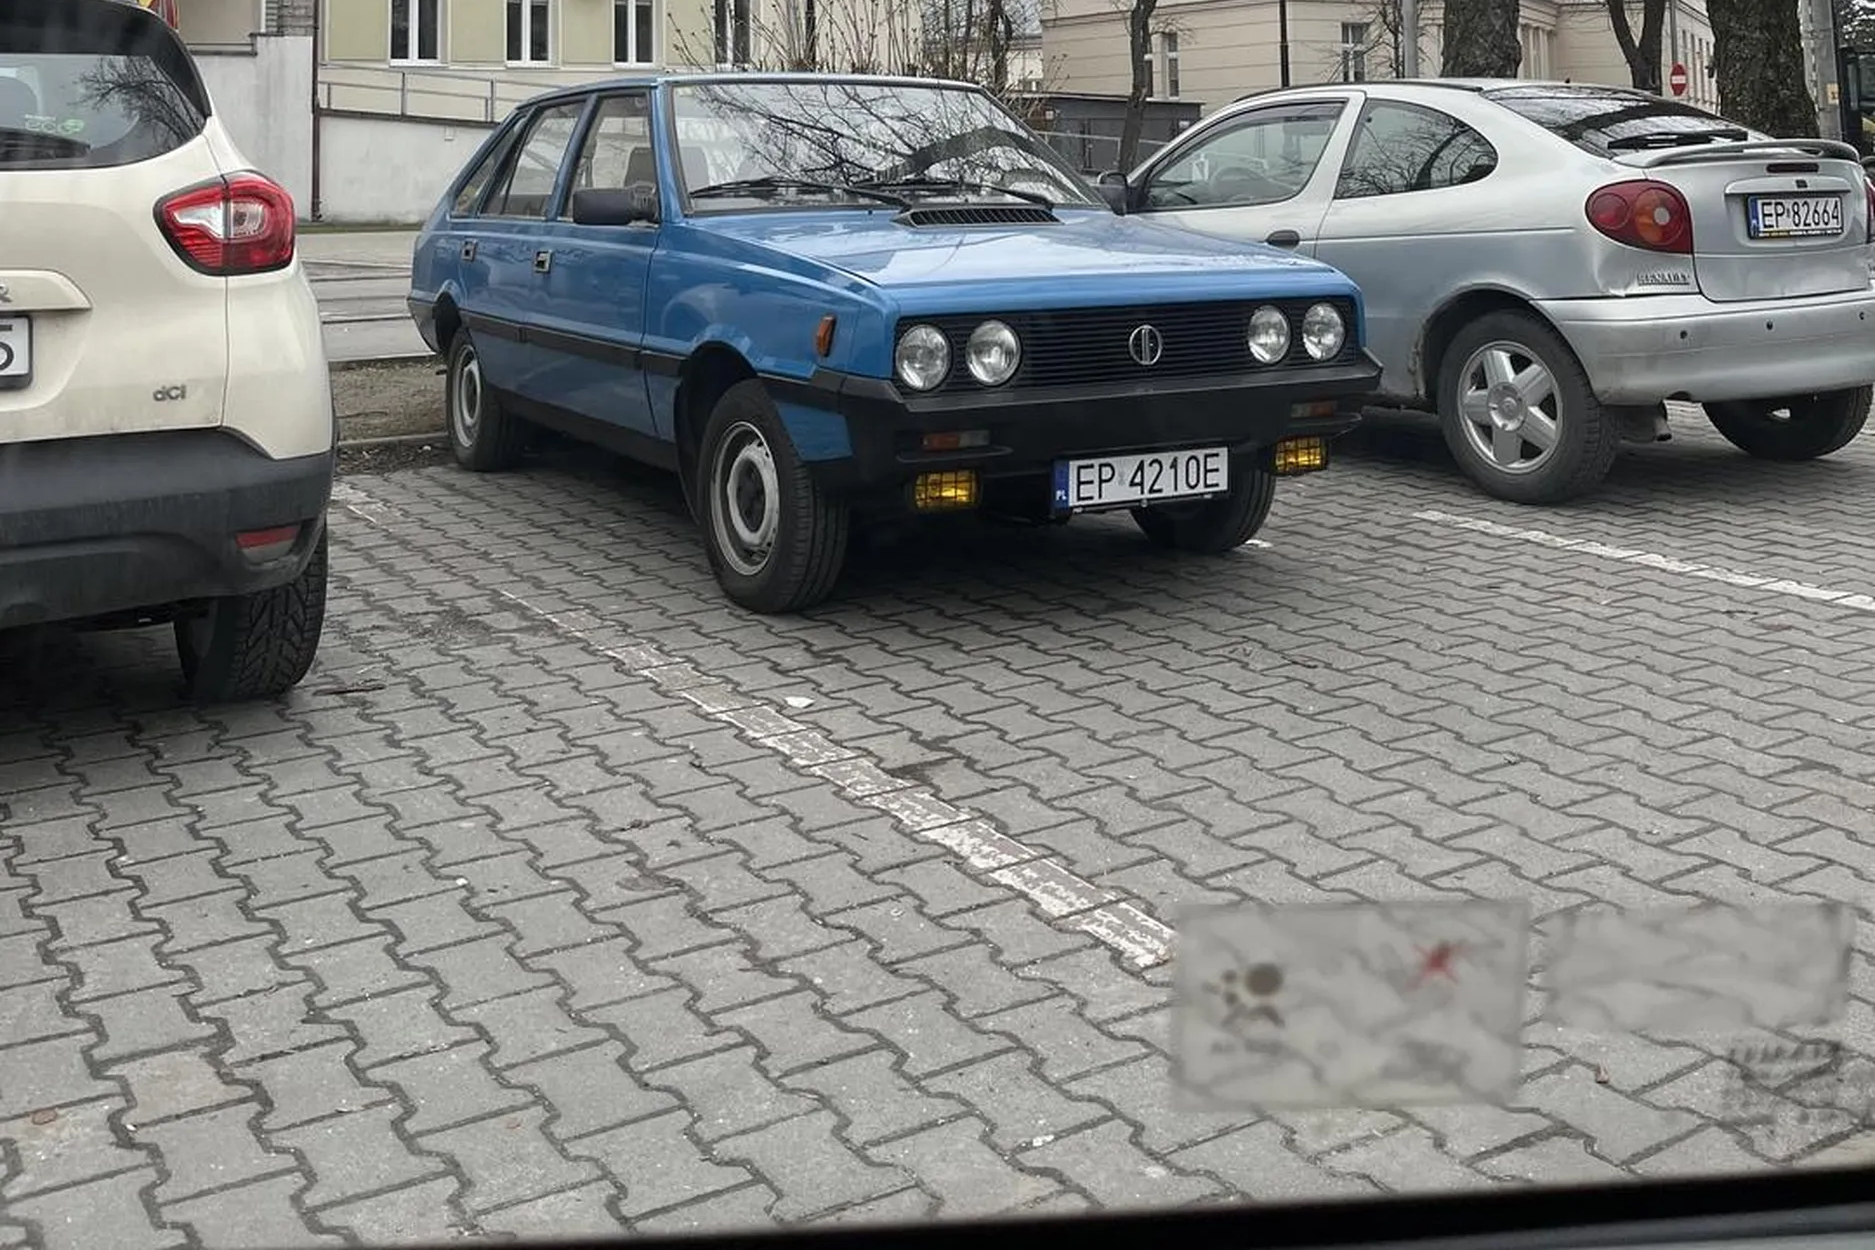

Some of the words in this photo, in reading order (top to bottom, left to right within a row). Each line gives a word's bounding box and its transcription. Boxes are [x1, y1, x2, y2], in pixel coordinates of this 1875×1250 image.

[1761, 201, 1786, 229] EP
[1791, 199, 1840, 228] 82664
[1076, 462, 1116, 502] EP
[1128, 452, 1220, 496] 4210E
